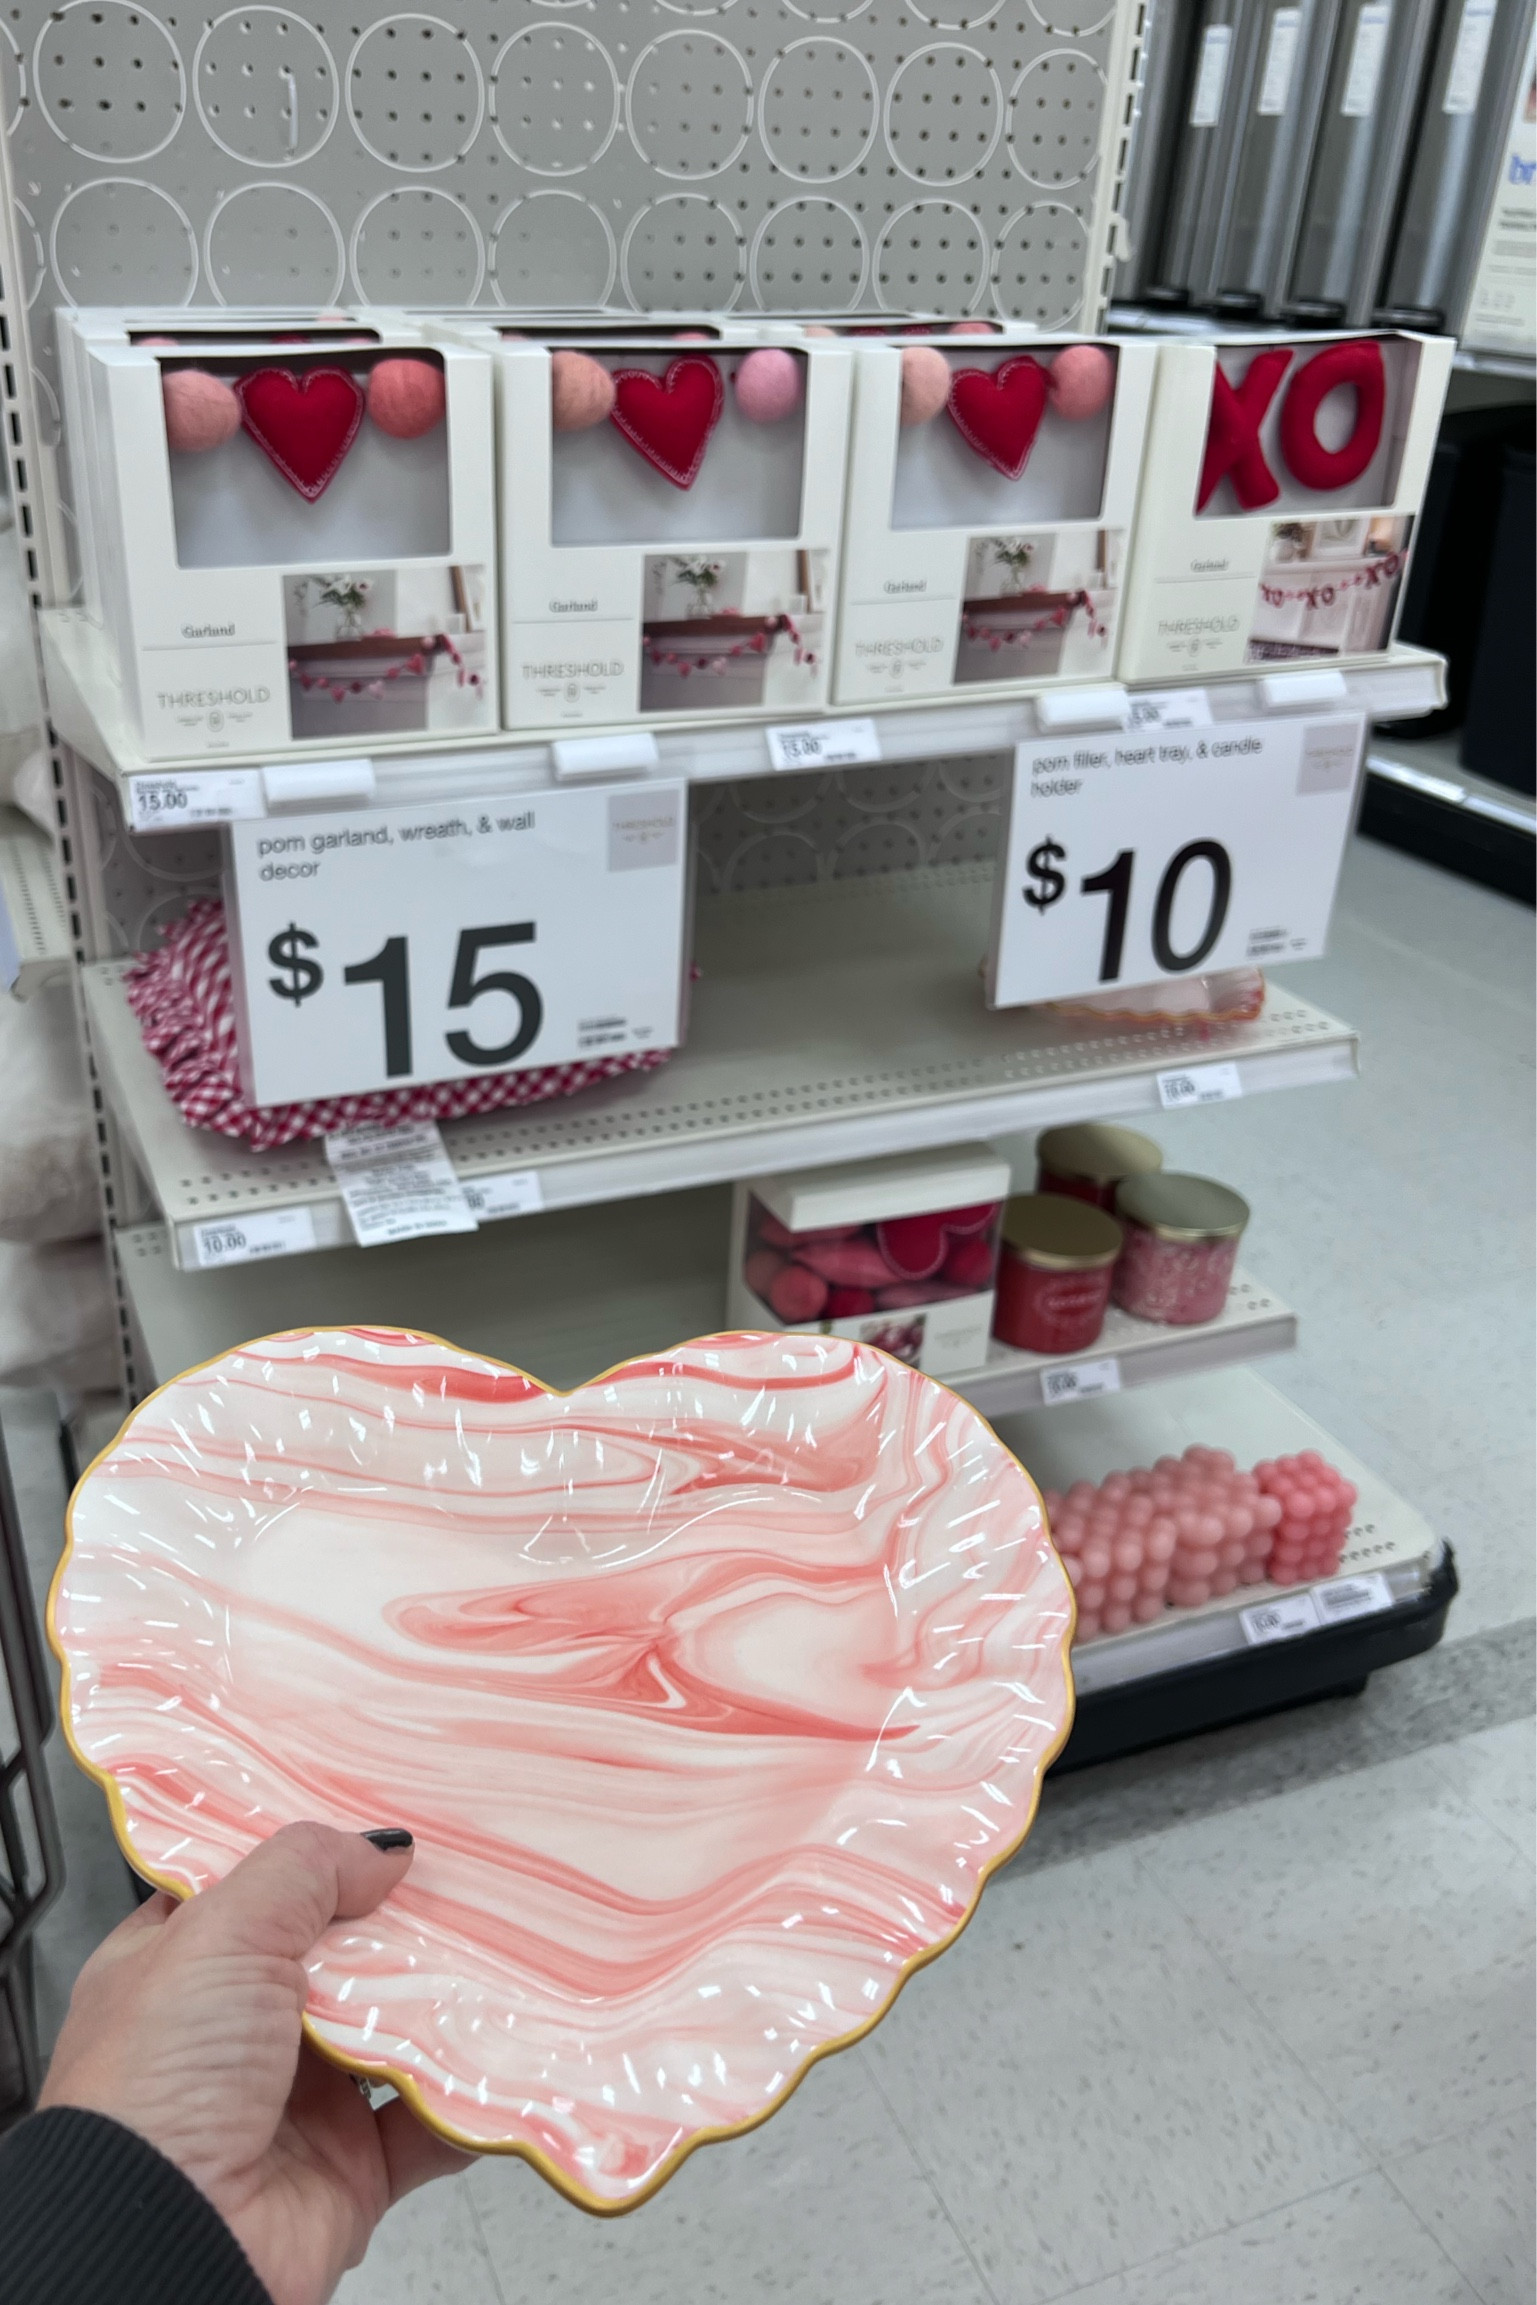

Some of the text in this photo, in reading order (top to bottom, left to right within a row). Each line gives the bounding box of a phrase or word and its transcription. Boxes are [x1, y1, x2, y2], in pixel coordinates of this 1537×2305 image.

[522, 661, 624, 679] THRESHOLD
[157, 687, 271, 709] THRESHOLD
[1115, 747, 1155, 766] heart
[1195, 740, 1208, 759] &
[1211, 735, 1263, 757] candle
[1031, 778, 1082, 797] holder
[138, 793, 188, 811] 15.00
[257, 810, 536, 856] pom garland, wreath, & wall
[259, 859, 321, 882] decor
[1022, 833, 1233, 983] $10
[267, 920, 544, 1080] $15
[203, 1232, 247, 1254] 10.00
